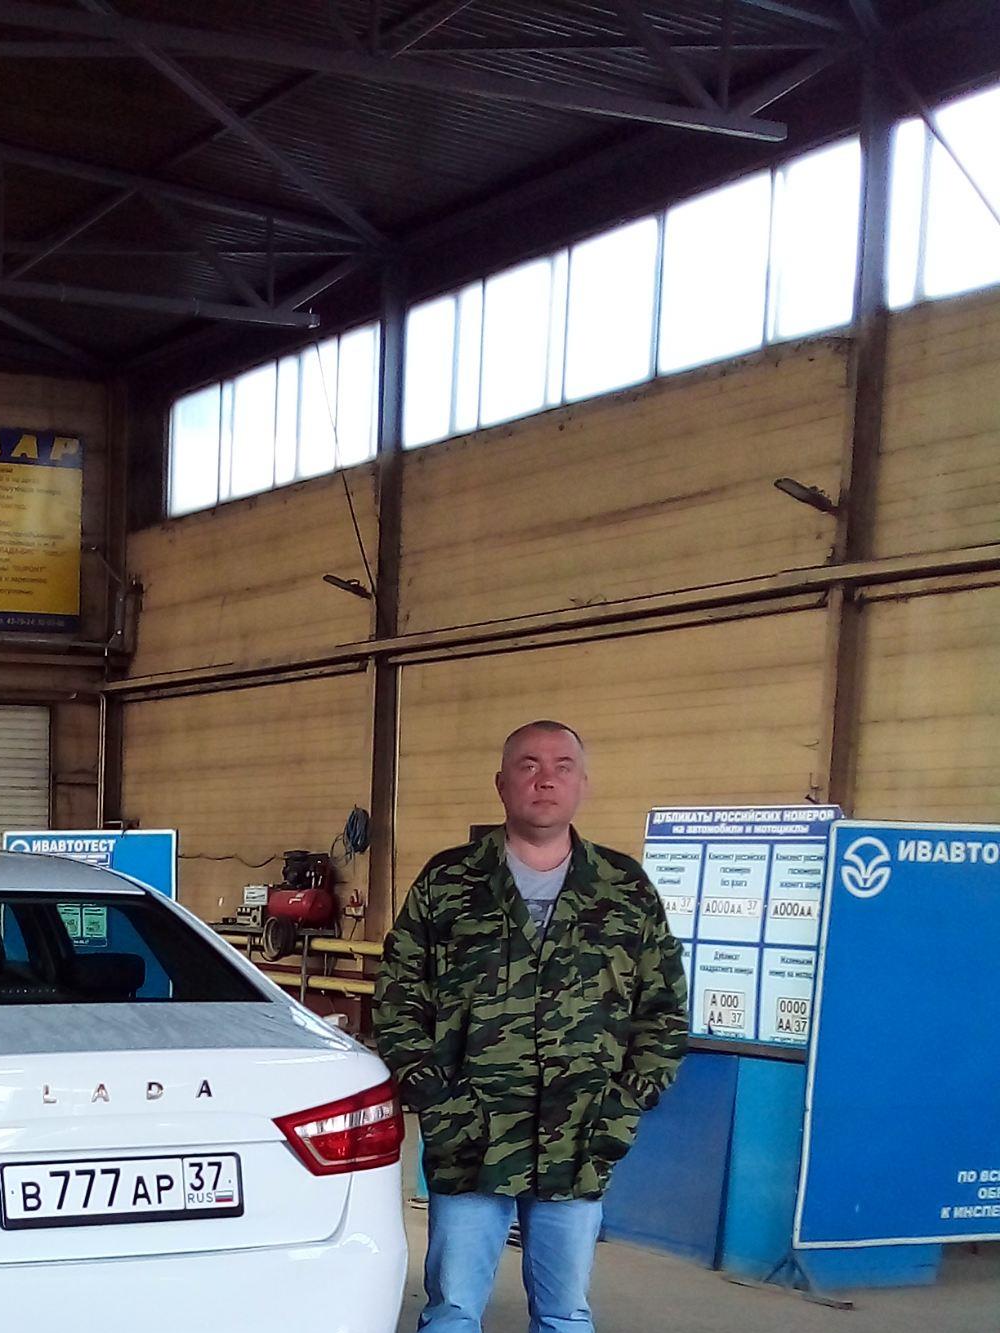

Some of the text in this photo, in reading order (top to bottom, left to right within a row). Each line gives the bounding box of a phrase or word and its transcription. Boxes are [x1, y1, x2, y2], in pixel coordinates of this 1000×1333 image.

[653, 808, 834, 824] ДУБЛИКАТЫ РОССИЙСКИХ НОМЕРОВ
[32, 839, 116, 852] ИВАВТОТЕСТ
[898, 839, 1000, 864] ИВАВТО
[779, 1000, 807, 1015] 0000
[731, 1012, 743, 1024] 37
[777, 1017, 808, 1033] АА 37
[42, 1079, 214, 1104] LADA
[957, 1169, 1000, 1183] ПО ВС
[20, 1161, 223, 1212] В777АР 37
[187, 1191, 214, 1204] RUS
